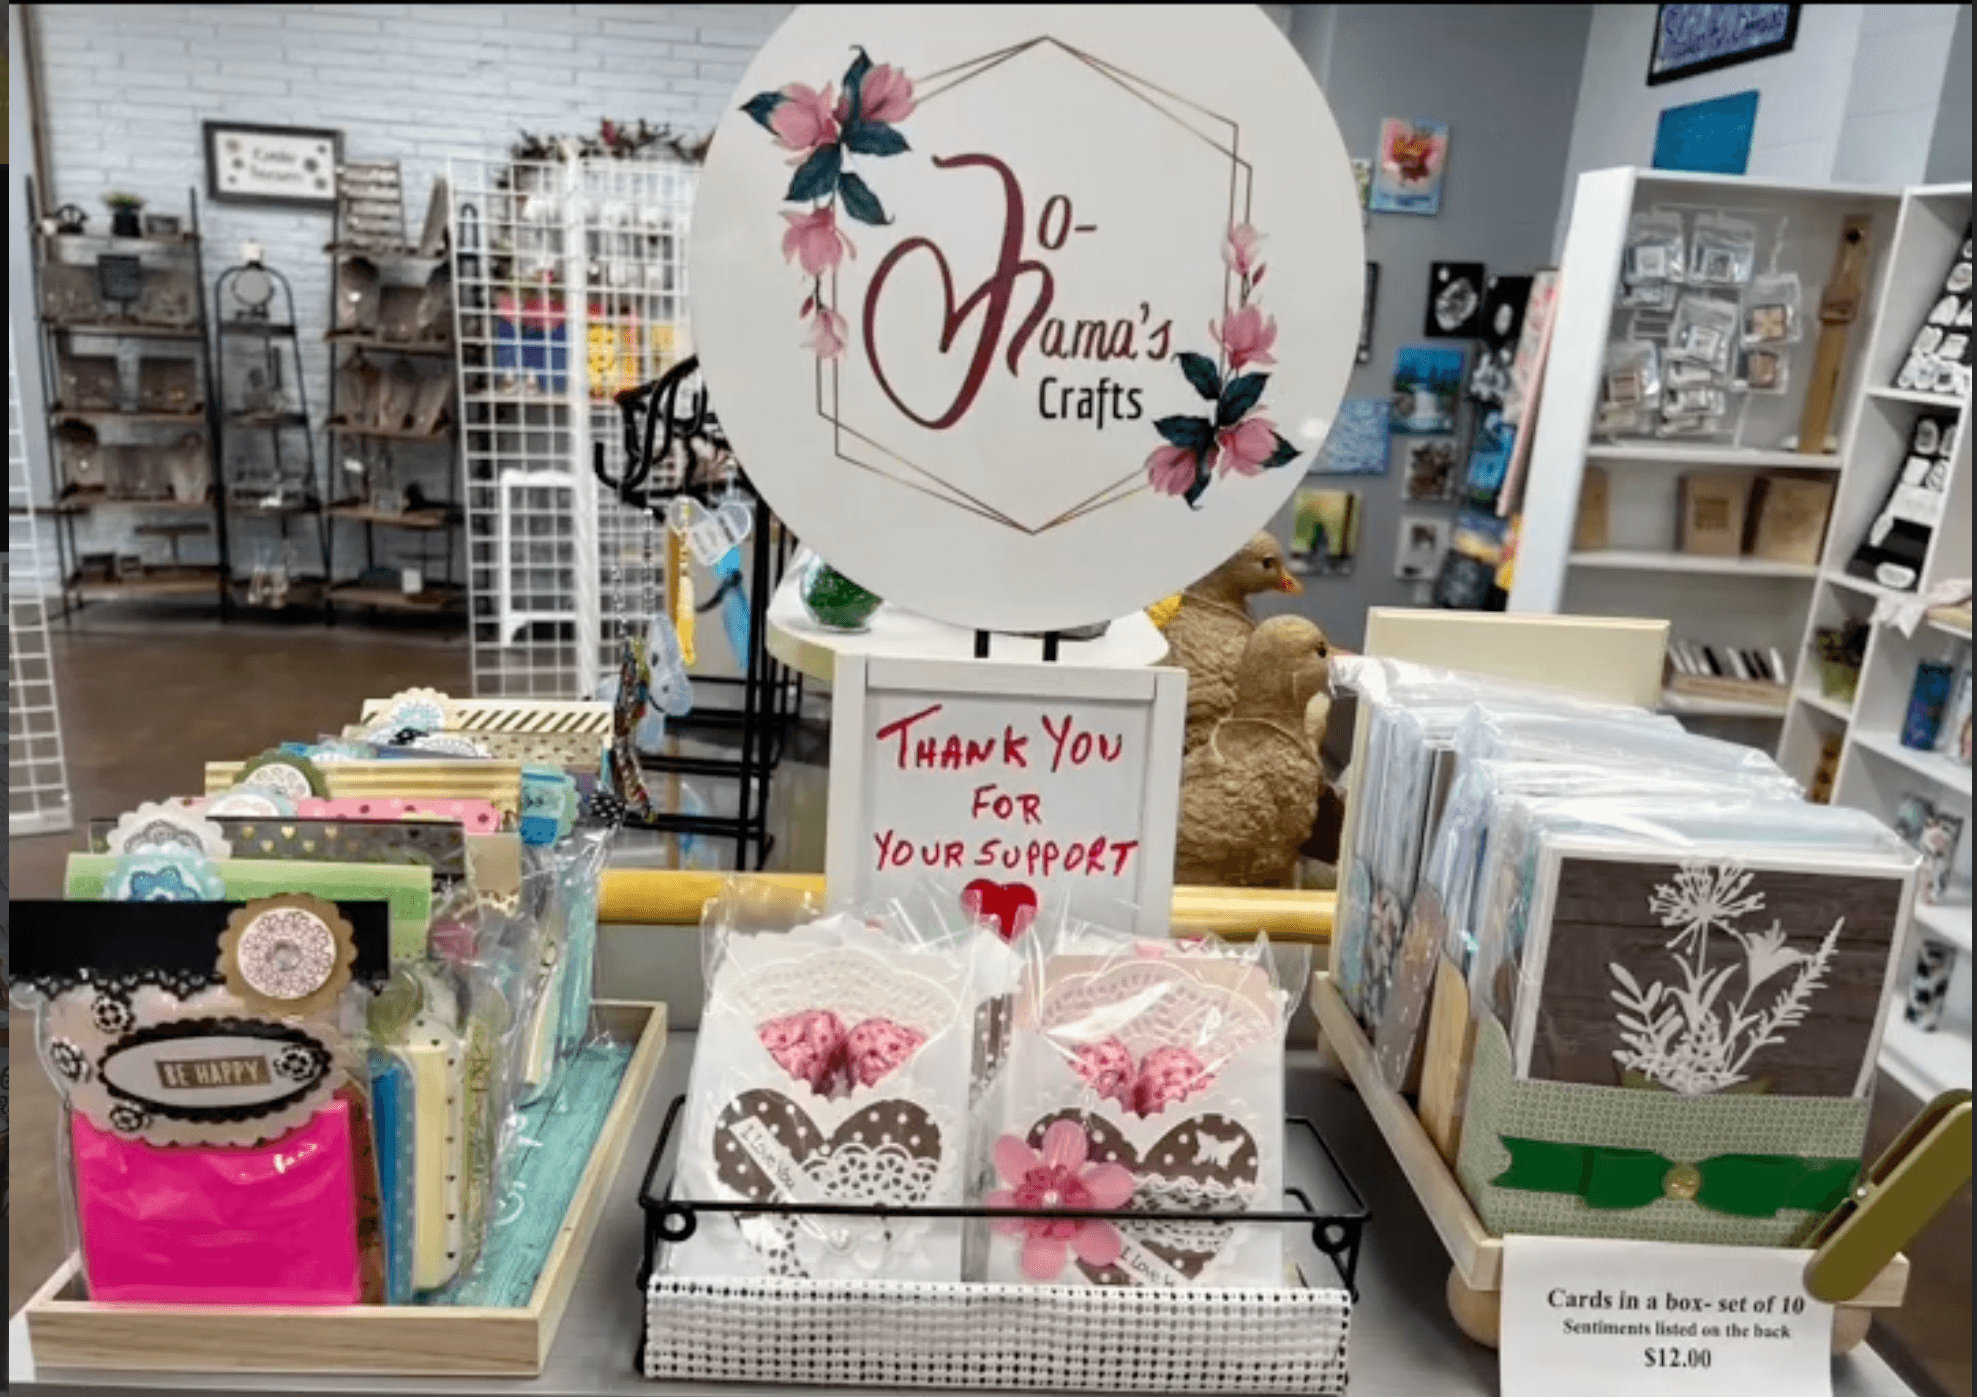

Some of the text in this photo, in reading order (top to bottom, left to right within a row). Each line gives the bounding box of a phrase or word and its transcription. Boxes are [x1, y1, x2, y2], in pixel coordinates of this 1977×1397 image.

[1038, 376, 1143, 430] Crafts
[876, 704, 1123, 773] THANK YOU
[971, 783, 1042, 825] FOR
[873, 829, 1139, 877] YOUR SUPPORT
[163, 1060, 259, 1087] BE HAPPY
[1547, 1287, 1805, 1315] Cards in a box- set of 10
[1562, 1318, 1791, 1339] Sentiments listed on the back
[1643, 1347, 1712, 1368] $12.00
